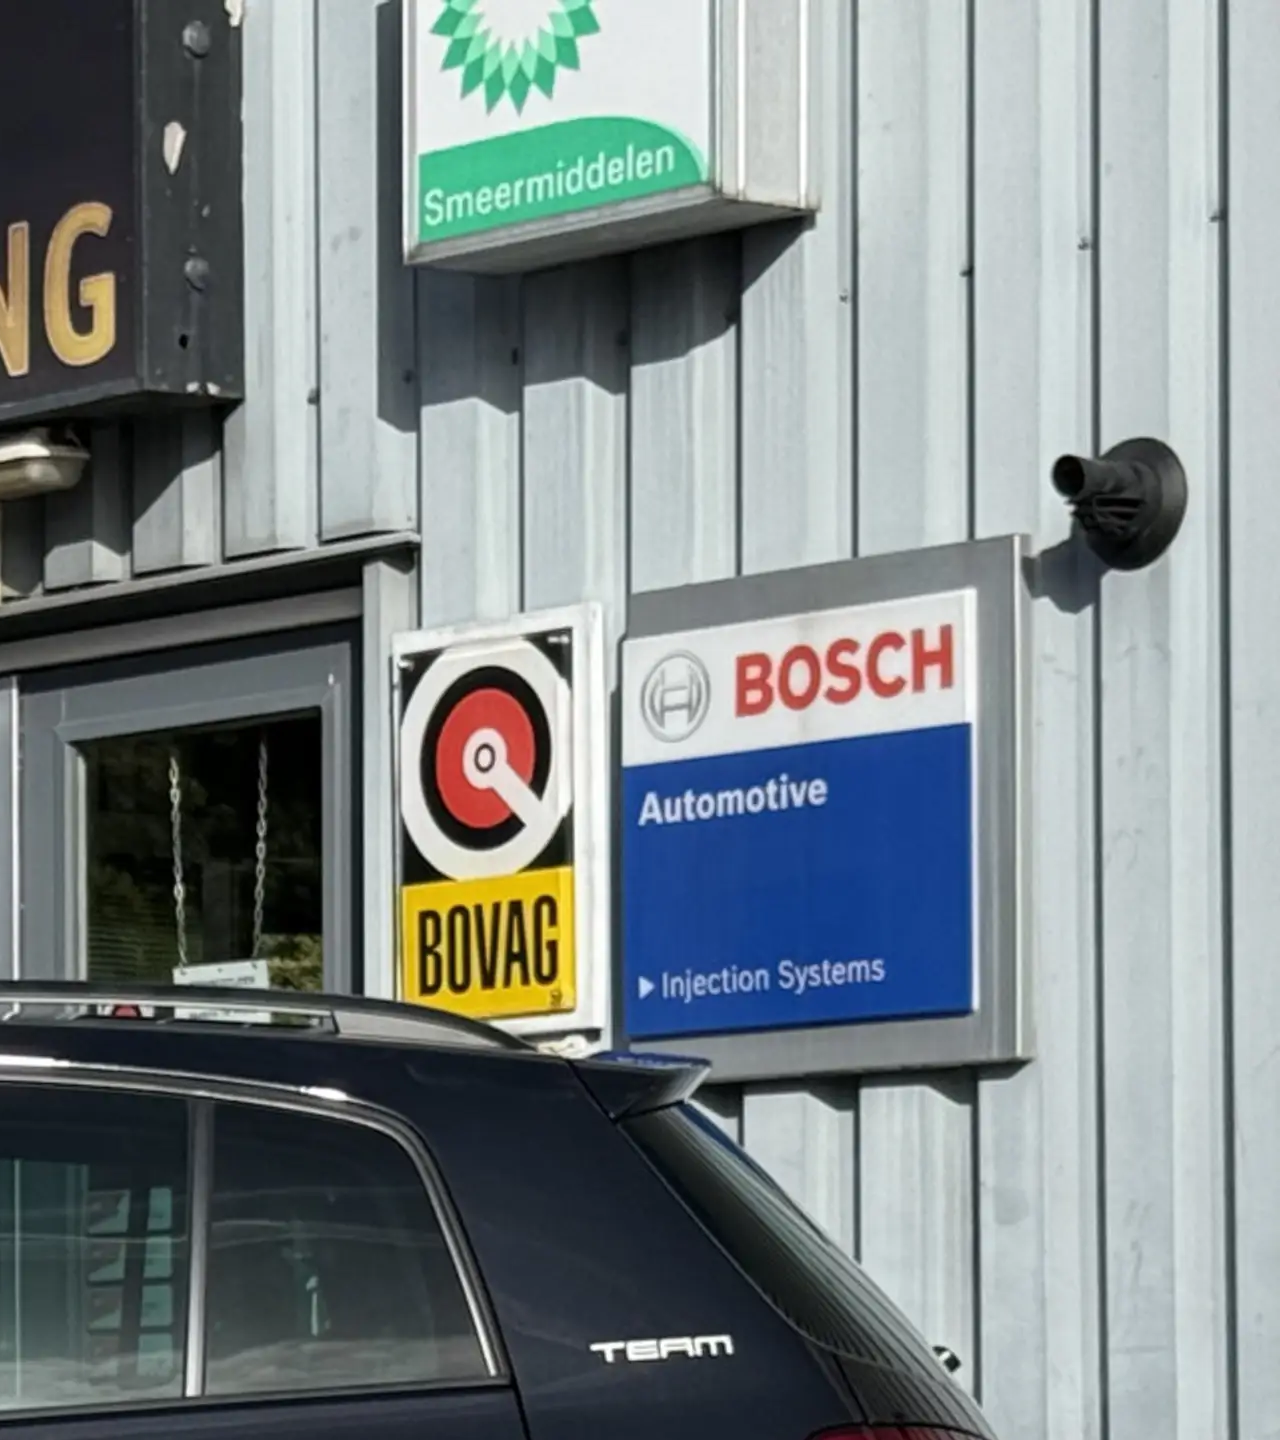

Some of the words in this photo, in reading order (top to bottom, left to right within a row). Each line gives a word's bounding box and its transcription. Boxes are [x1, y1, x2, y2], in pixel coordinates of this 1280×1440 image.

[424, 143, 674, 226] Smeermiddelen
[735, 624, 954, 718] BOSCH
[638, 773, 828, 827] Automotive
[419, 894, 558, 996] BOVAG
[662, 962, 769, 1004] Injection
[777, 958, 886, 994] Systems
[590, 1334, 734, 1363] TEAM
